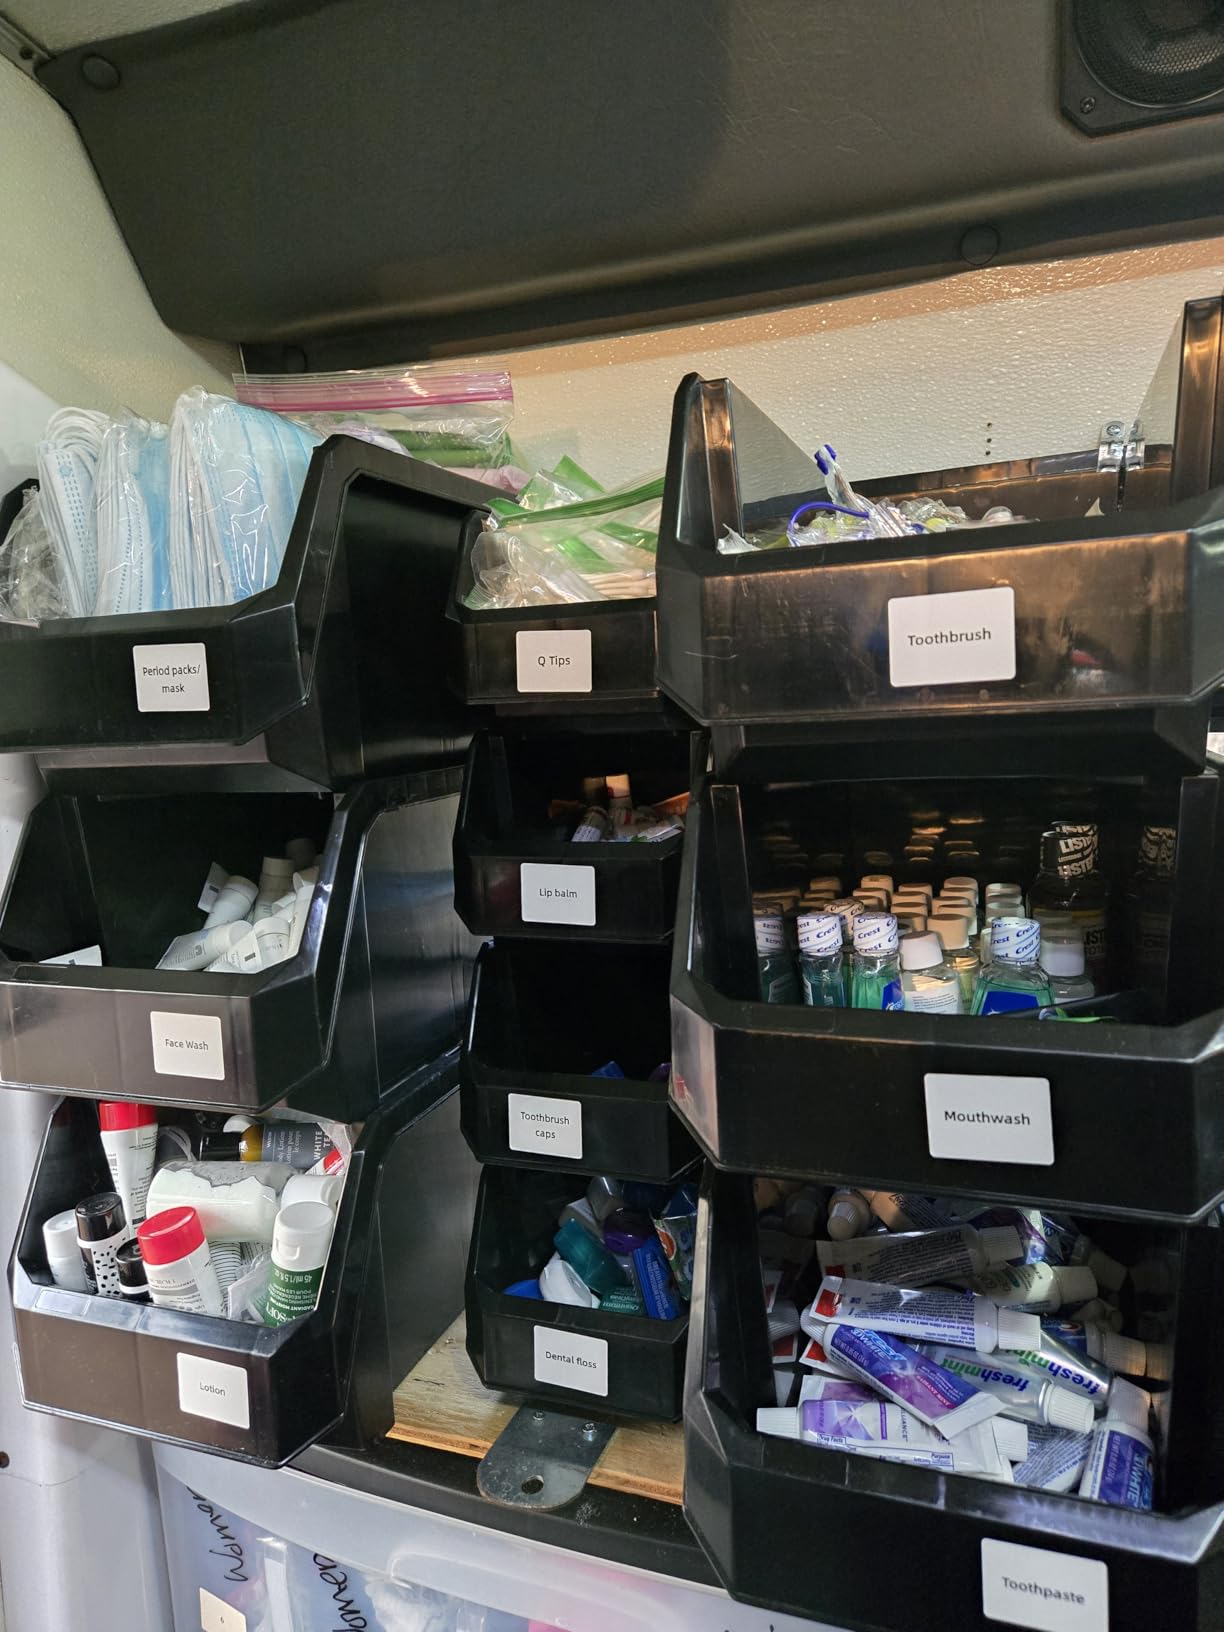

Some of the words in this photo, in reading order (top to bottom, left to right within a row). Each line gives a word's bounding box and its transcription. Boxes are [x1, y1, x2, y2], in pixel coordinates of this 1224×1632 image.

[907, 627, 992, 647] Toothbrush
[537, 655, 547, 668] Q
[548, 655, 571, 668] Tips
[142, 664, 170, 677] Period
[171, 664, 201, 677] packs/
[161, 682, 185, 694] mask
[538, 887, 553, 899] Lip
[554, 888, 578, 899] balm
[816, 924, 837, 939] Crest
[858, 927, 881, 939] Crest
[1016, 941, 1034, 954] Crest
[164, 1038, 184, 1050] Face
[185, 1039, 209, 1051] Wash
[520, 1111, 570, 1125] Toothbrush
[943, 1110, 1031, 1127] Mouthwash
[535, 1129, 556, 1140] caps
[314, 1131, 322, 1160] WHITE
[545, 1350, 575, 1365] Dental
[576, 1354, 597, 1369] floss
[199, 1382, 226, 1397] Lotion
[313, 1553, 367, 1632] omen
[1002, 1576, 1086, 1605] Toothpaste
